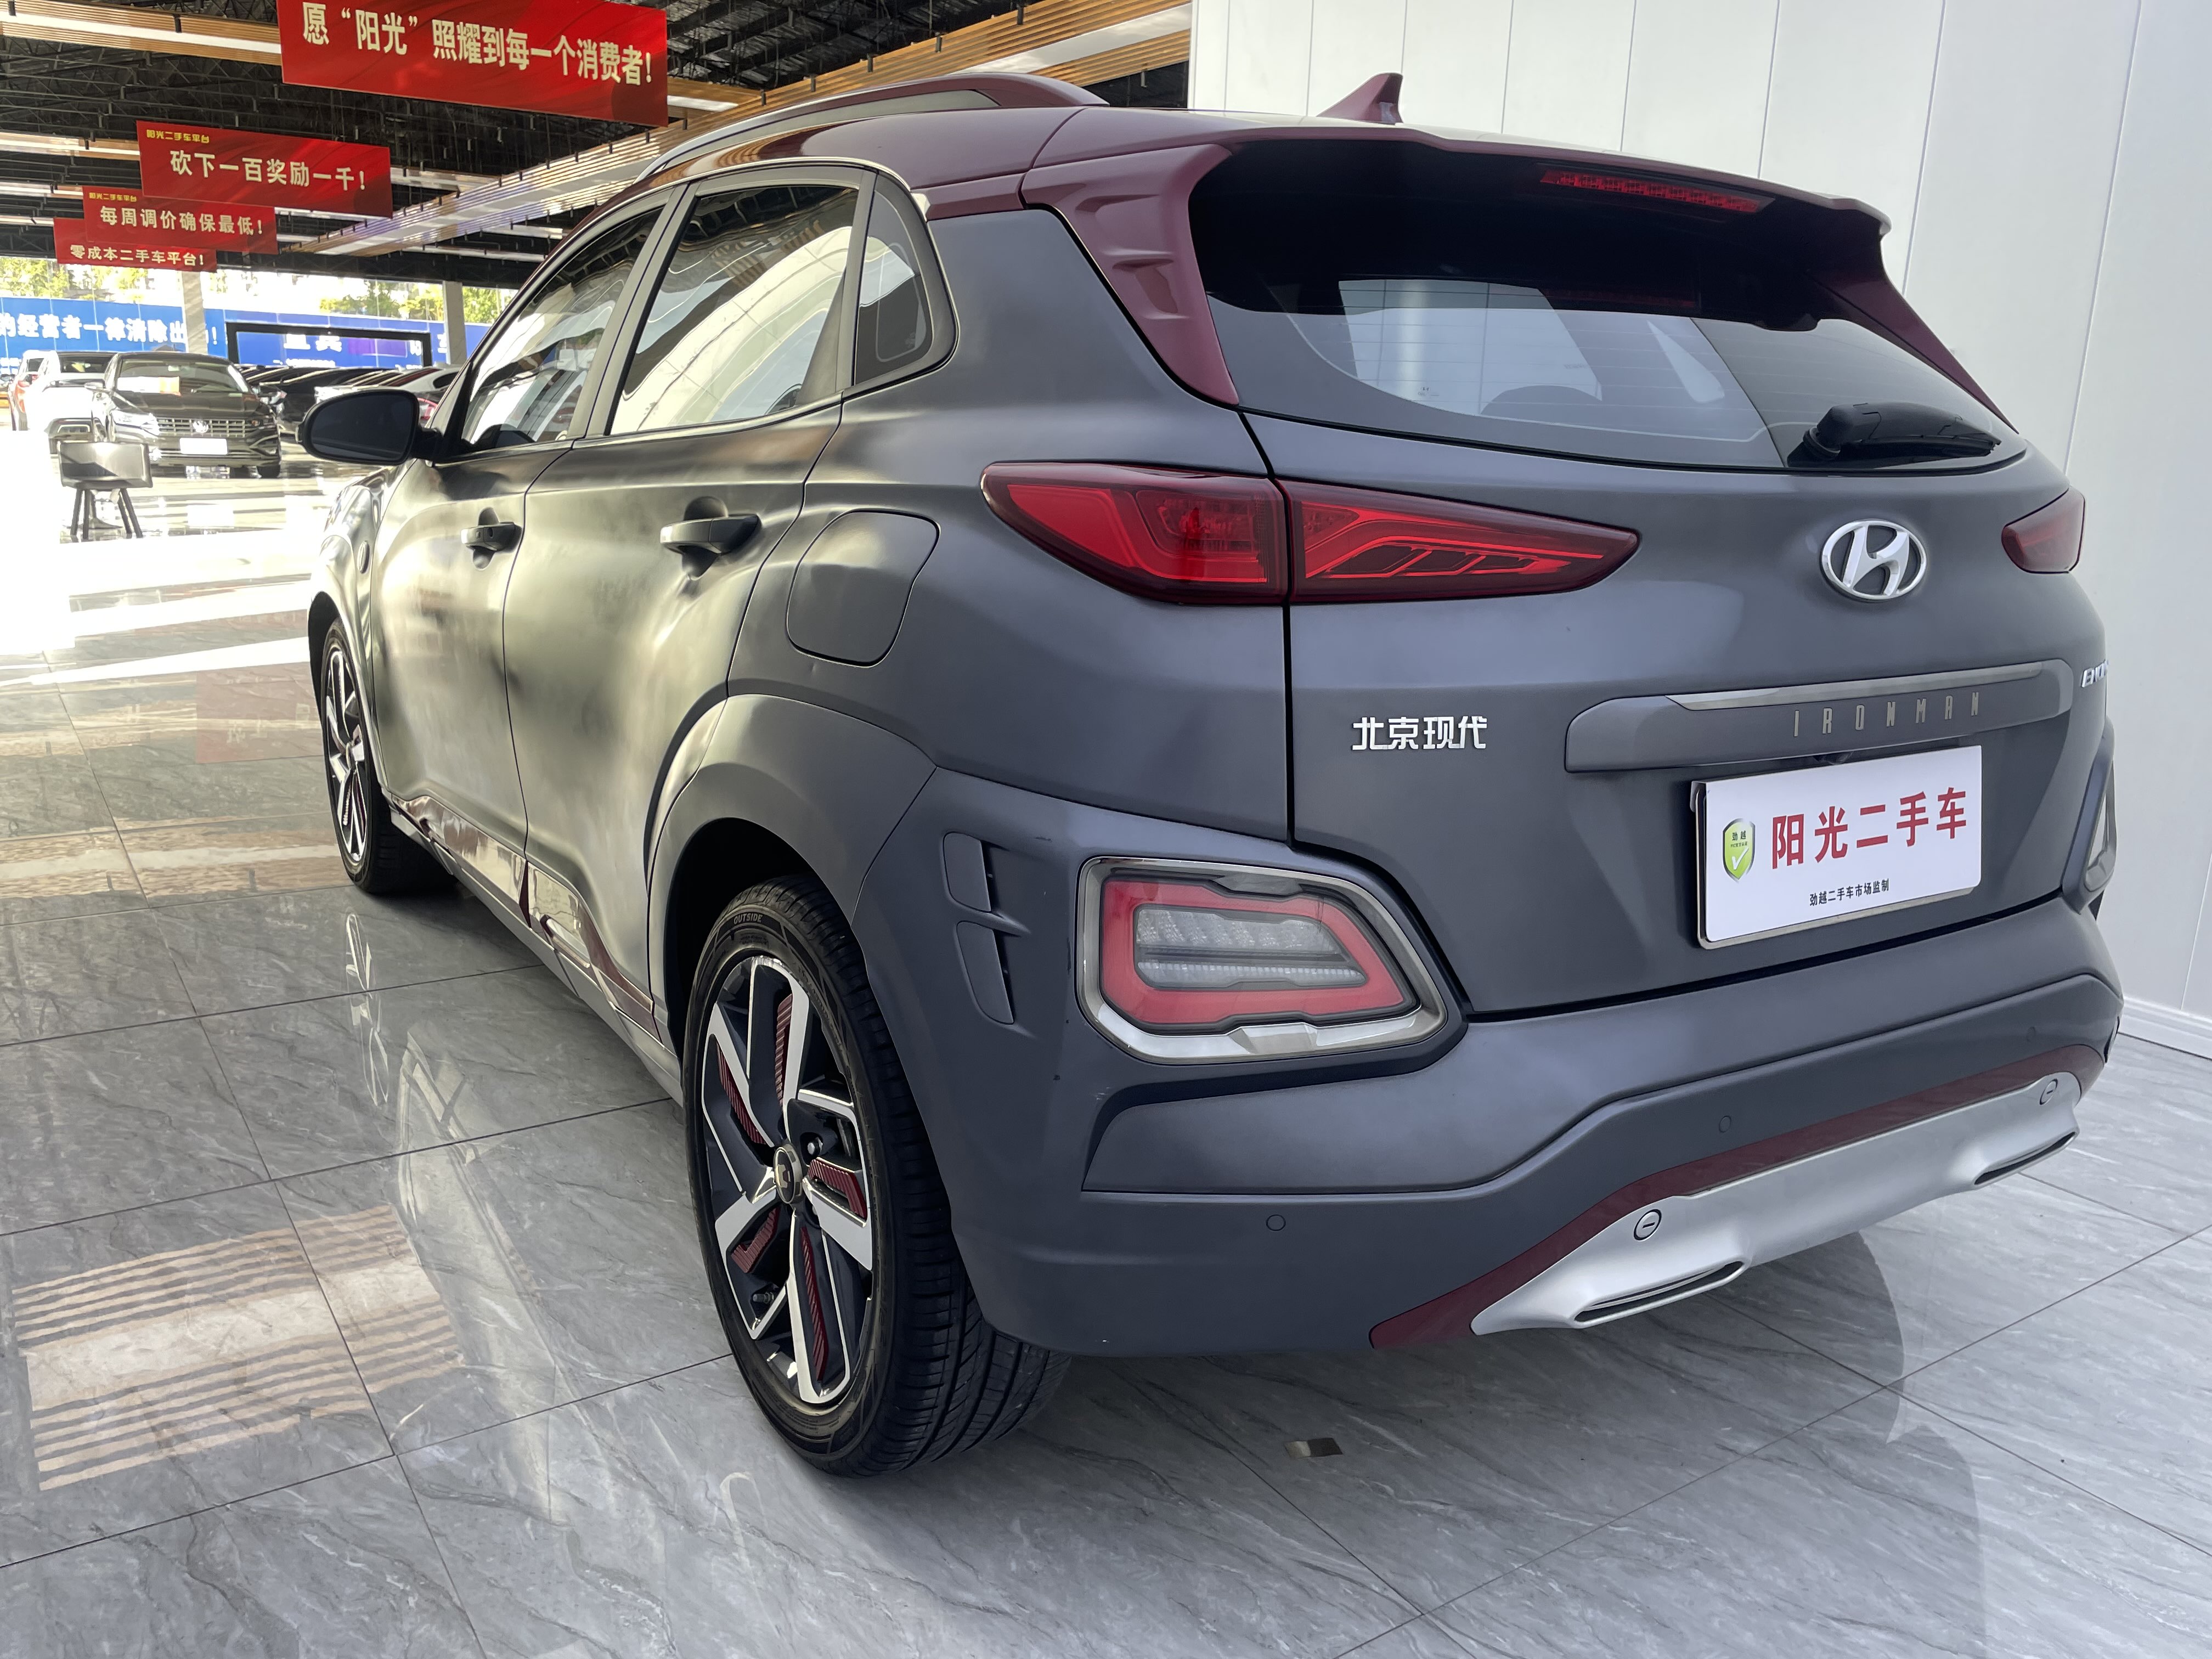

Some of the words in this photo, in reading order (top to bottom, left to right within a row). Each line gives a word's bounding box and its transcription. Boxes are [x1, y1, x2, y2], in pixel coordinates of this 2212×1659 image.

[170, 149, 366, 191] 砍下一百奖励一千!
[100, 205, 263, 235] 每周调价确保最低!
[70, 244, 204, 266] 零成本二手车平台!
[1793, 692, 1979, 737] IRONMAN
[1352, 715, 1487, 751] 北京现代
[1772, 787, 1967, 870] 阳光二手车
[1809, 878, 1889, 906] 劲越二手车市场监制
[733, 913, 763, 924] OUTSIDE
